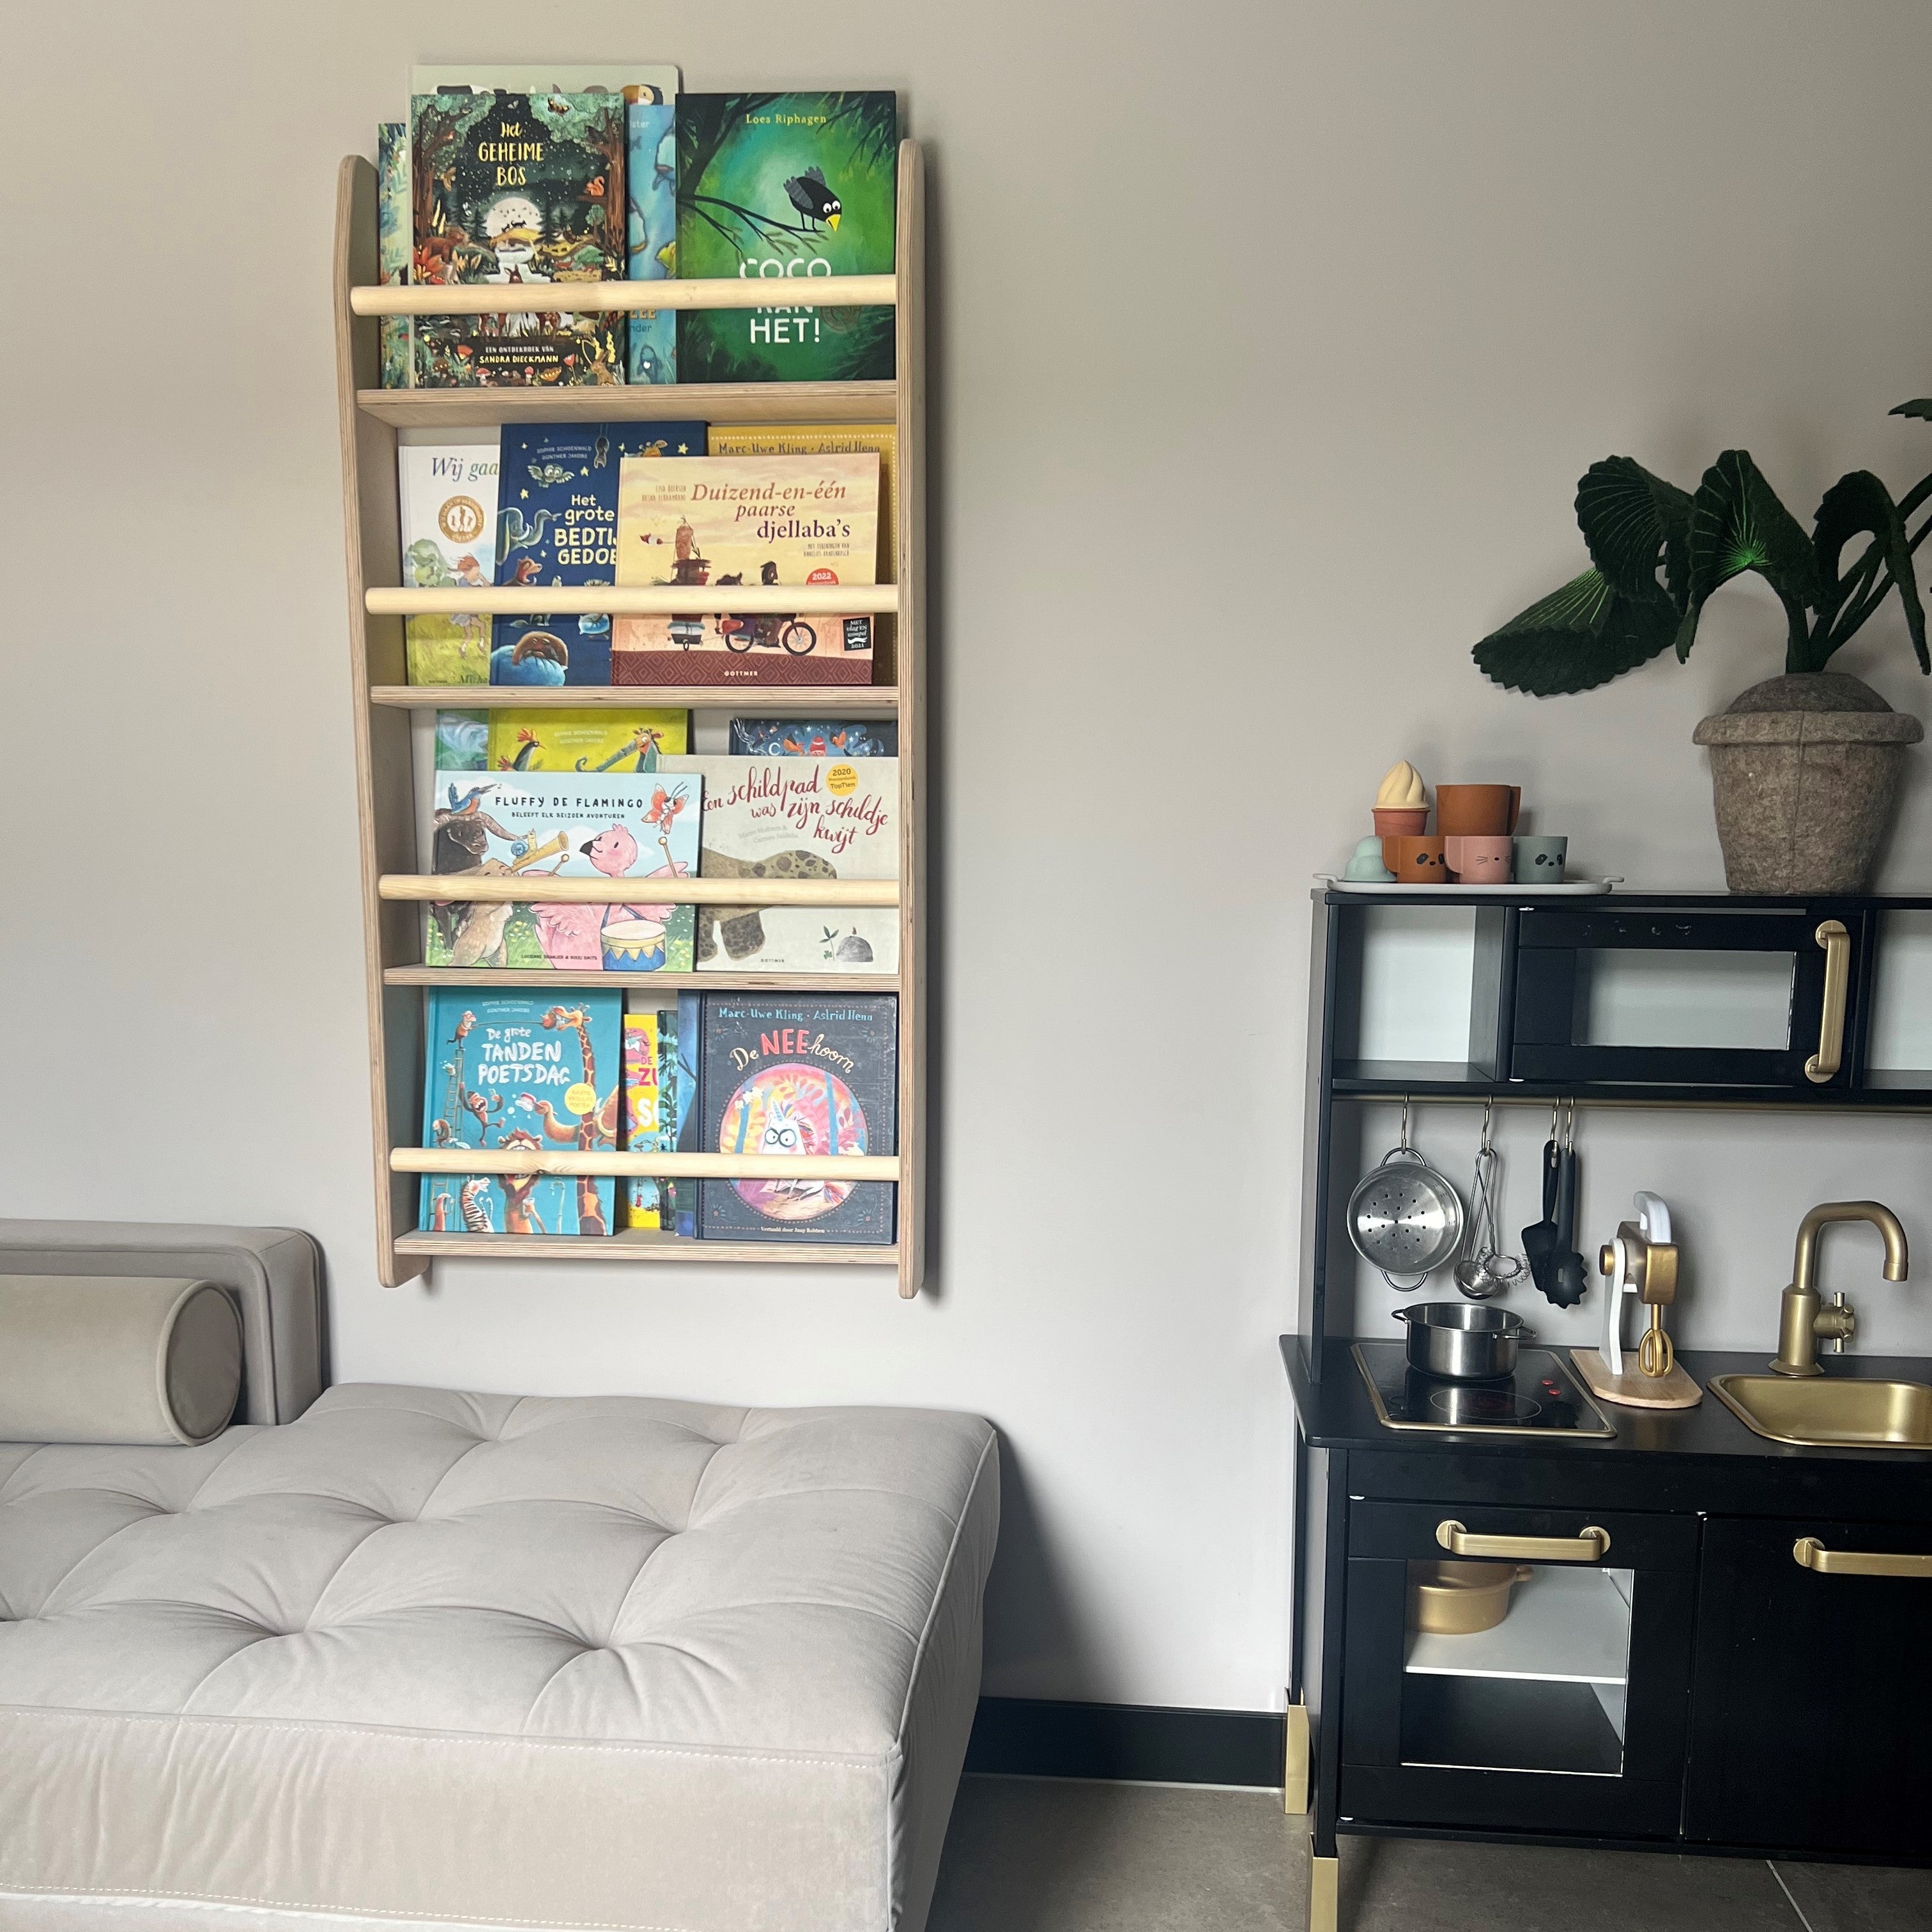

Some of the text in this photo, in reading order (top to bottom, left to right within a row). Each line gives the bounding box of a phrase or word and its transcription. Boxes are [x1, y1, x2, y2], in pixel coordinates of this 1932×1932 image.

[500, 121, 523, 138] Het
[746, 113, 827, 126] Loes Riphagen
[478, 141, 544, 162] GEHEIME
[497, 166, 526, 186] BOS
[739, 257, 832, 279] COCO
[750, 318, 820, 344] HET!
[479, 355, 510, 364] SANDRA
[778, 442, 807, 454] Kling
[818, 441, 851, 453] Astrid
[432, 457, 463, 482] Wij
[571, 494, 597, 506] Het
[691, 480, 846, 501] Duizend-en-één
[565, 505, 615, 526] grote
[734, 504, 795, 522] paarse
[757, 519, 850, 544] djellaba's
[812, 572, 832, 581] 2022
[832, 768, 851, 776] 2020
[727, 764, 822, 811] schildpad
[495, 797, 643, 808] FLUFFY DE FLAMINGO
[751, 794, 889, 836] was zijn schildje
[813, 815, 858, 854] kwijt
[718, 1007, 873, 1022] Marc-Uwe Kling Astrid Henn
[486, 1026, 532, 1043] De grote
[481, 1039, 562, 1062] TANDEN
[641, 1056, 653, 1065] DE
[729, 1028, 854, 1074] De NEEhoorn
[478, 1063, 571, 1086] POETSDAG
